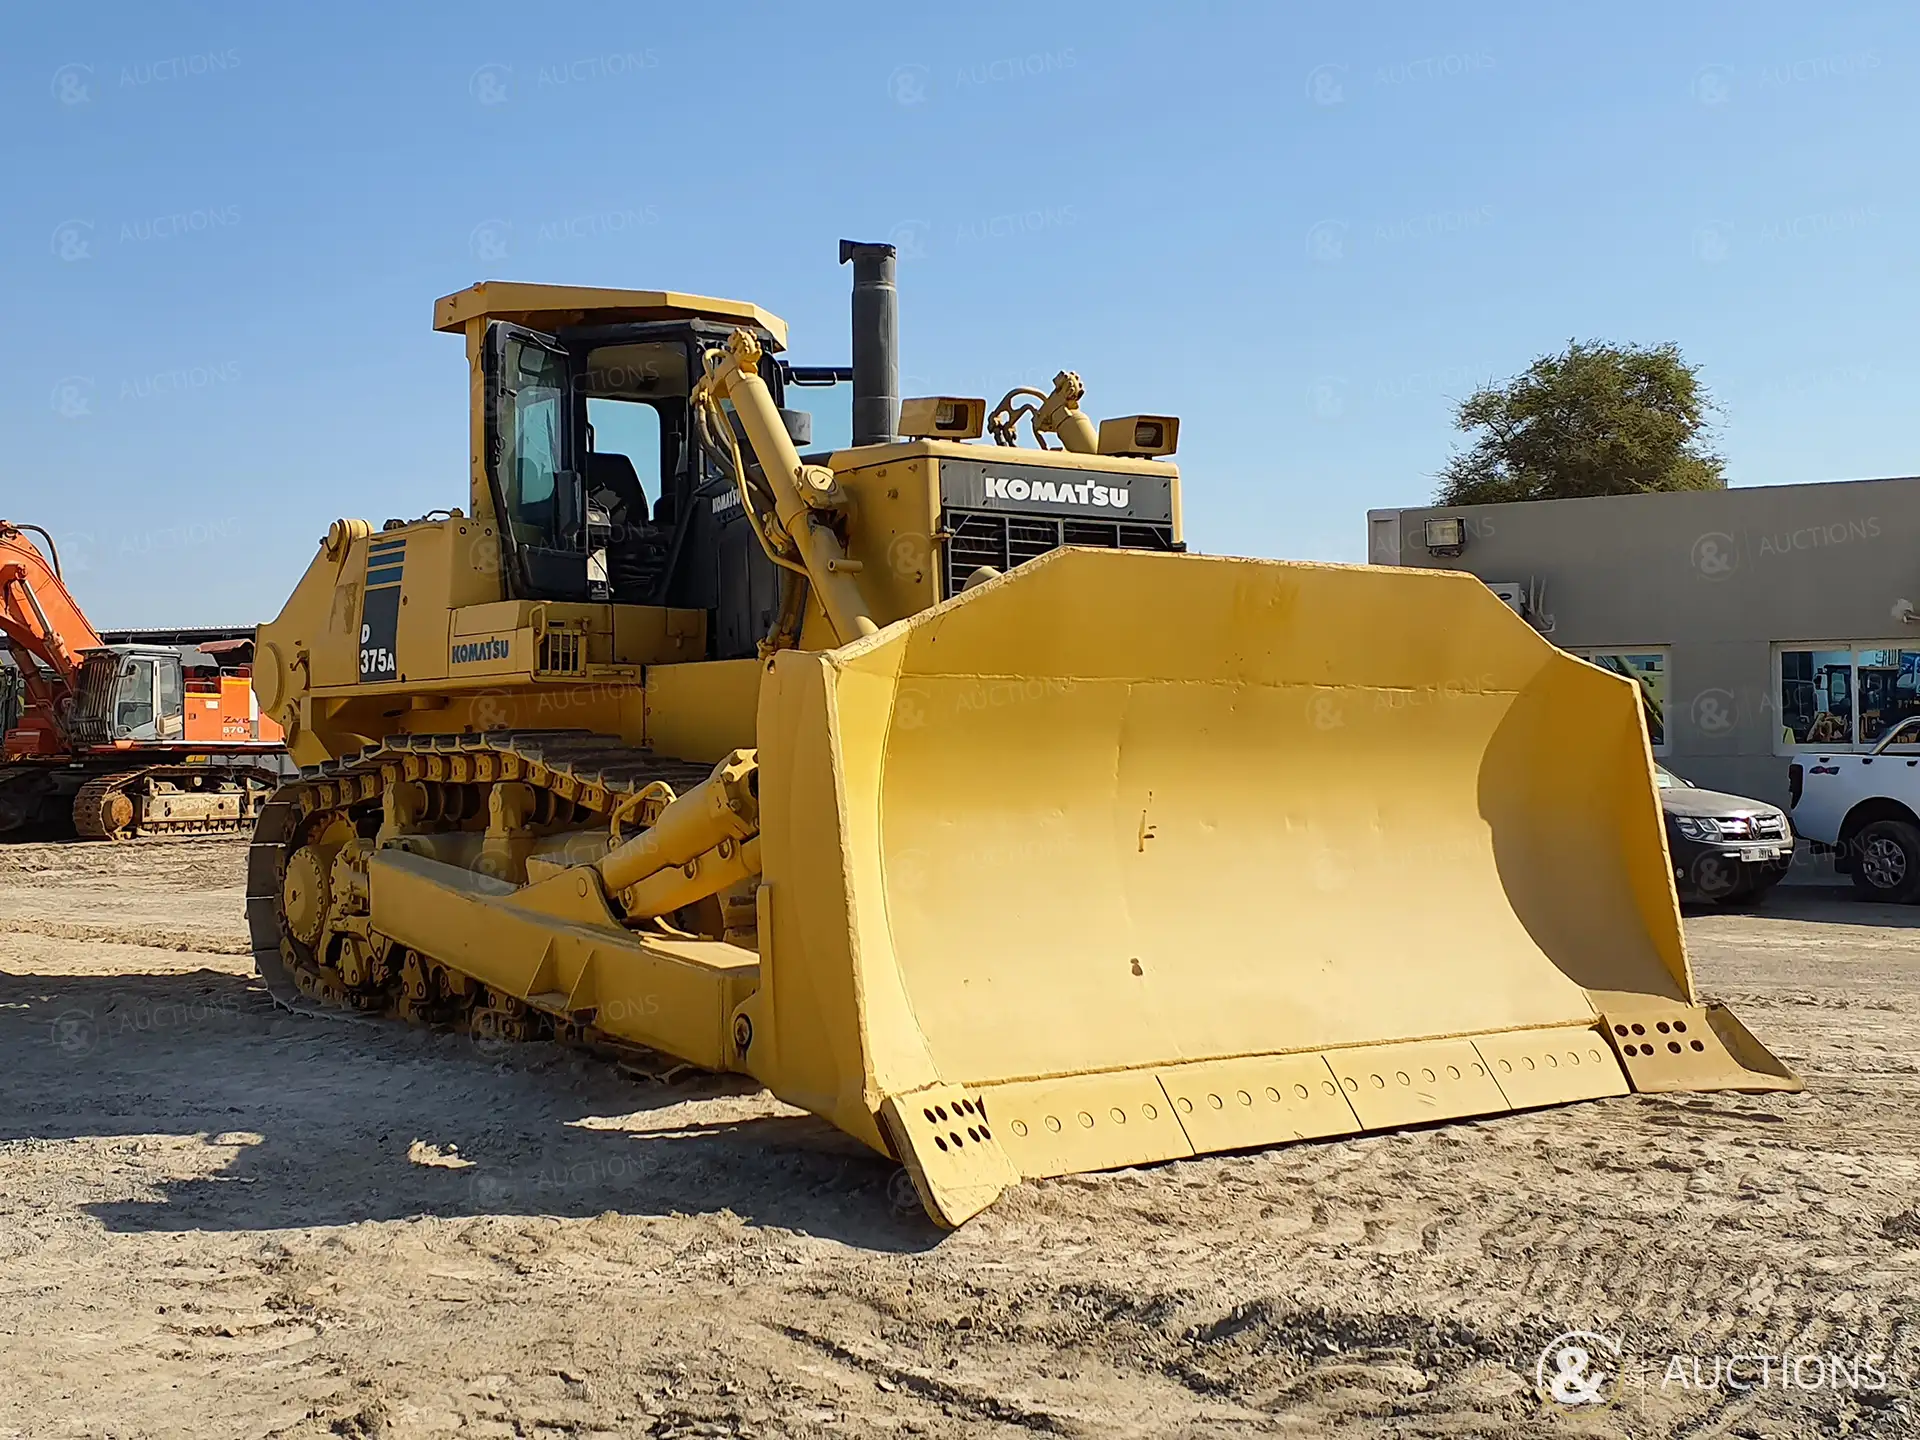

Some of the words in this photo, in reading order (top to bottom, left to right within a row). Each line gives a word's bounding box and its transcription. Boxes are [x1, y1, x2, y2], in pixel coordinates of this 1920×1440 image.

[985, 477, 1129, 508] KOMATSU
[361, 623, 371, 644] D
[360, 648, 396, 674] 375A
[452, 636, 509, 664] KOMATSU
